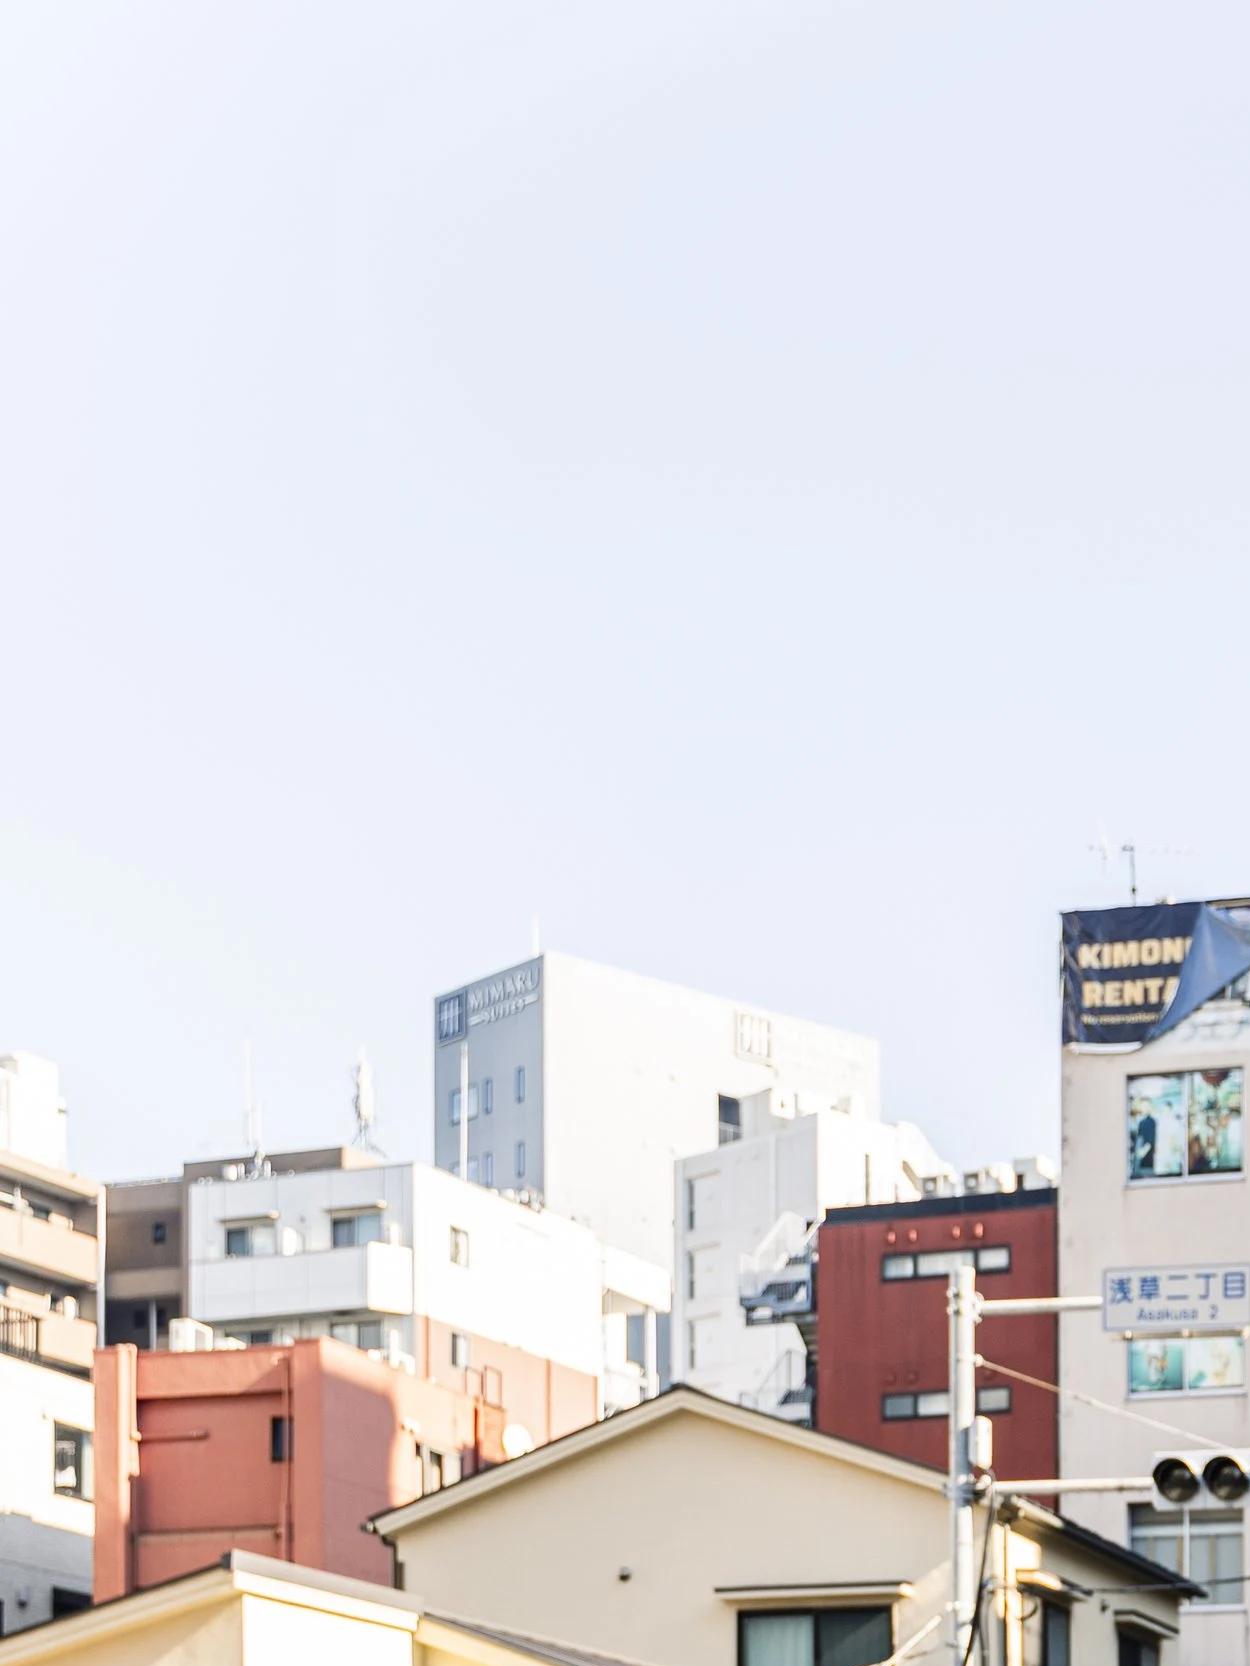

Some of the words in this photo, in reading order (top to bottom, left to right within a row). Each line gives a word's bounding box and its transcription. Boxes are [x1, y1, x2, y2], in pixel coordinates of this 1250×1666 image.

[467, 966, 539, 1013] MIMARU
[1110, 1271, 1245, 1304] 浅草二丁目
[1137, 1307, 1199, 1321] Asakusa
[1208, 1304, 1219, 1320] 2
